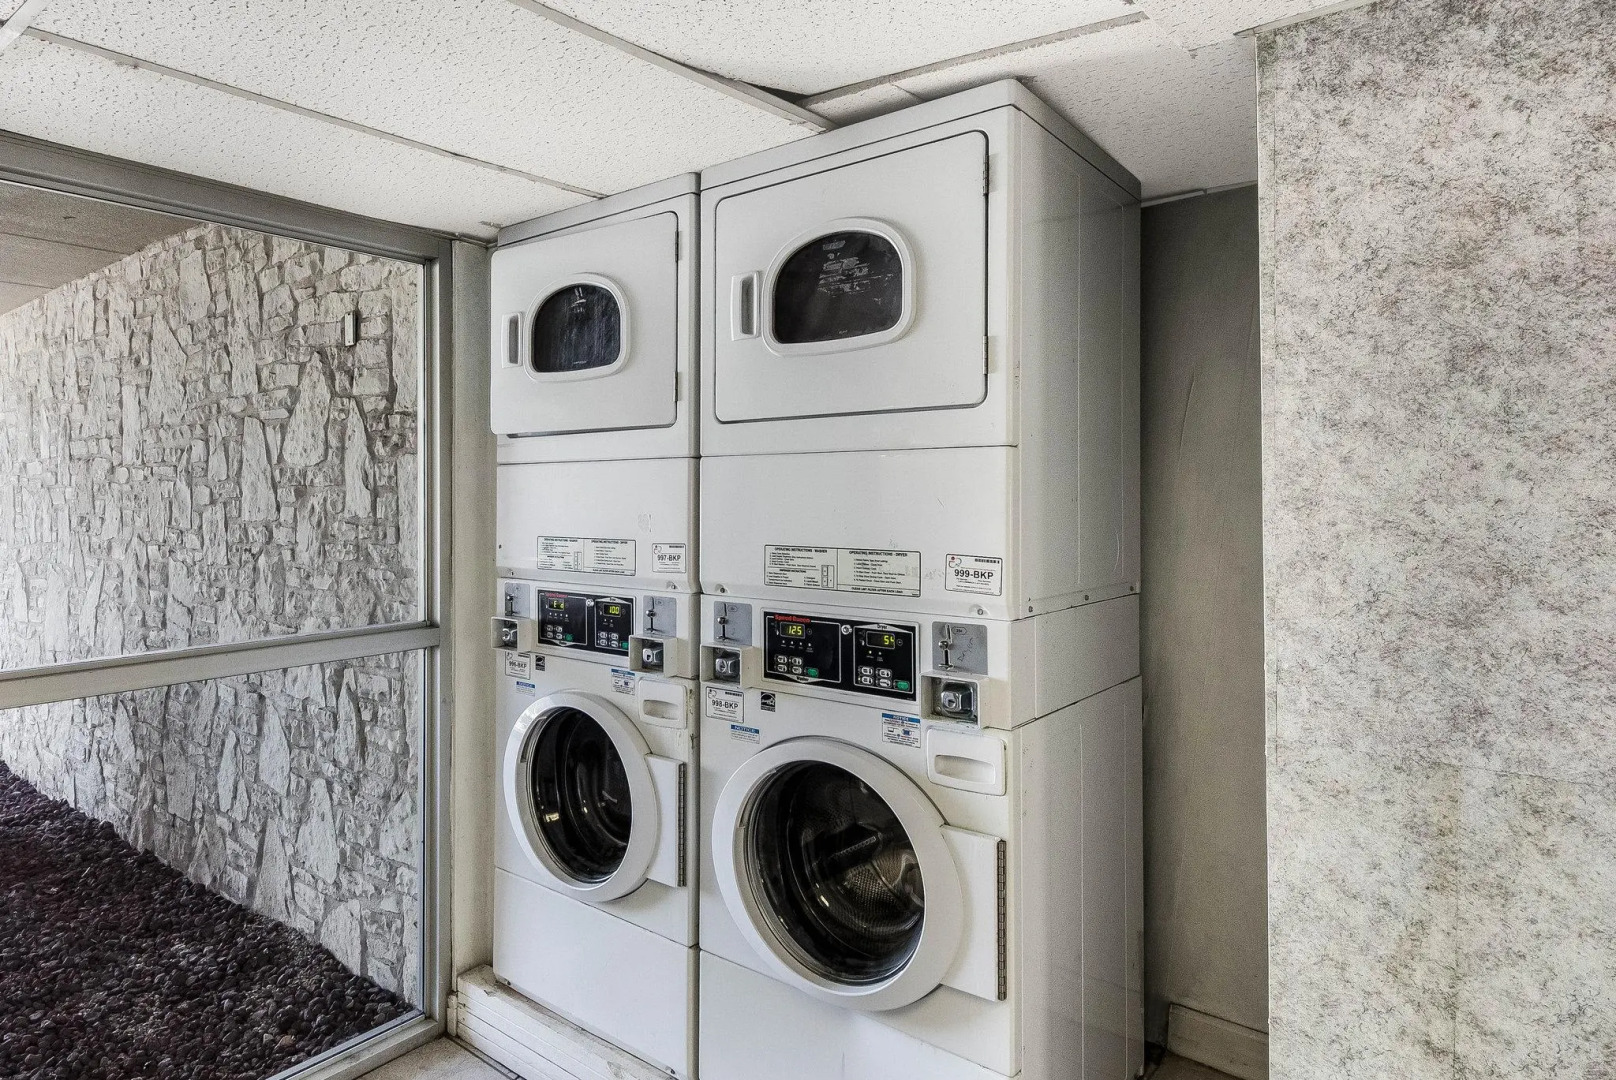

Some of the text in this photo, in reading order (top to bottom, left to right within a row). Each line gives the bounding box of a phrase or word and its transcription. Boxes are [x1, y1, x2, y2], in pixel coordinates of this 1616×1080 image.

[954, 569, 994, 580] 999-BKP
[788, 625, 803, 636] 125
[877, 623, 888, 631] Dryer
[711, 699, 739, 709] 998-BKP
